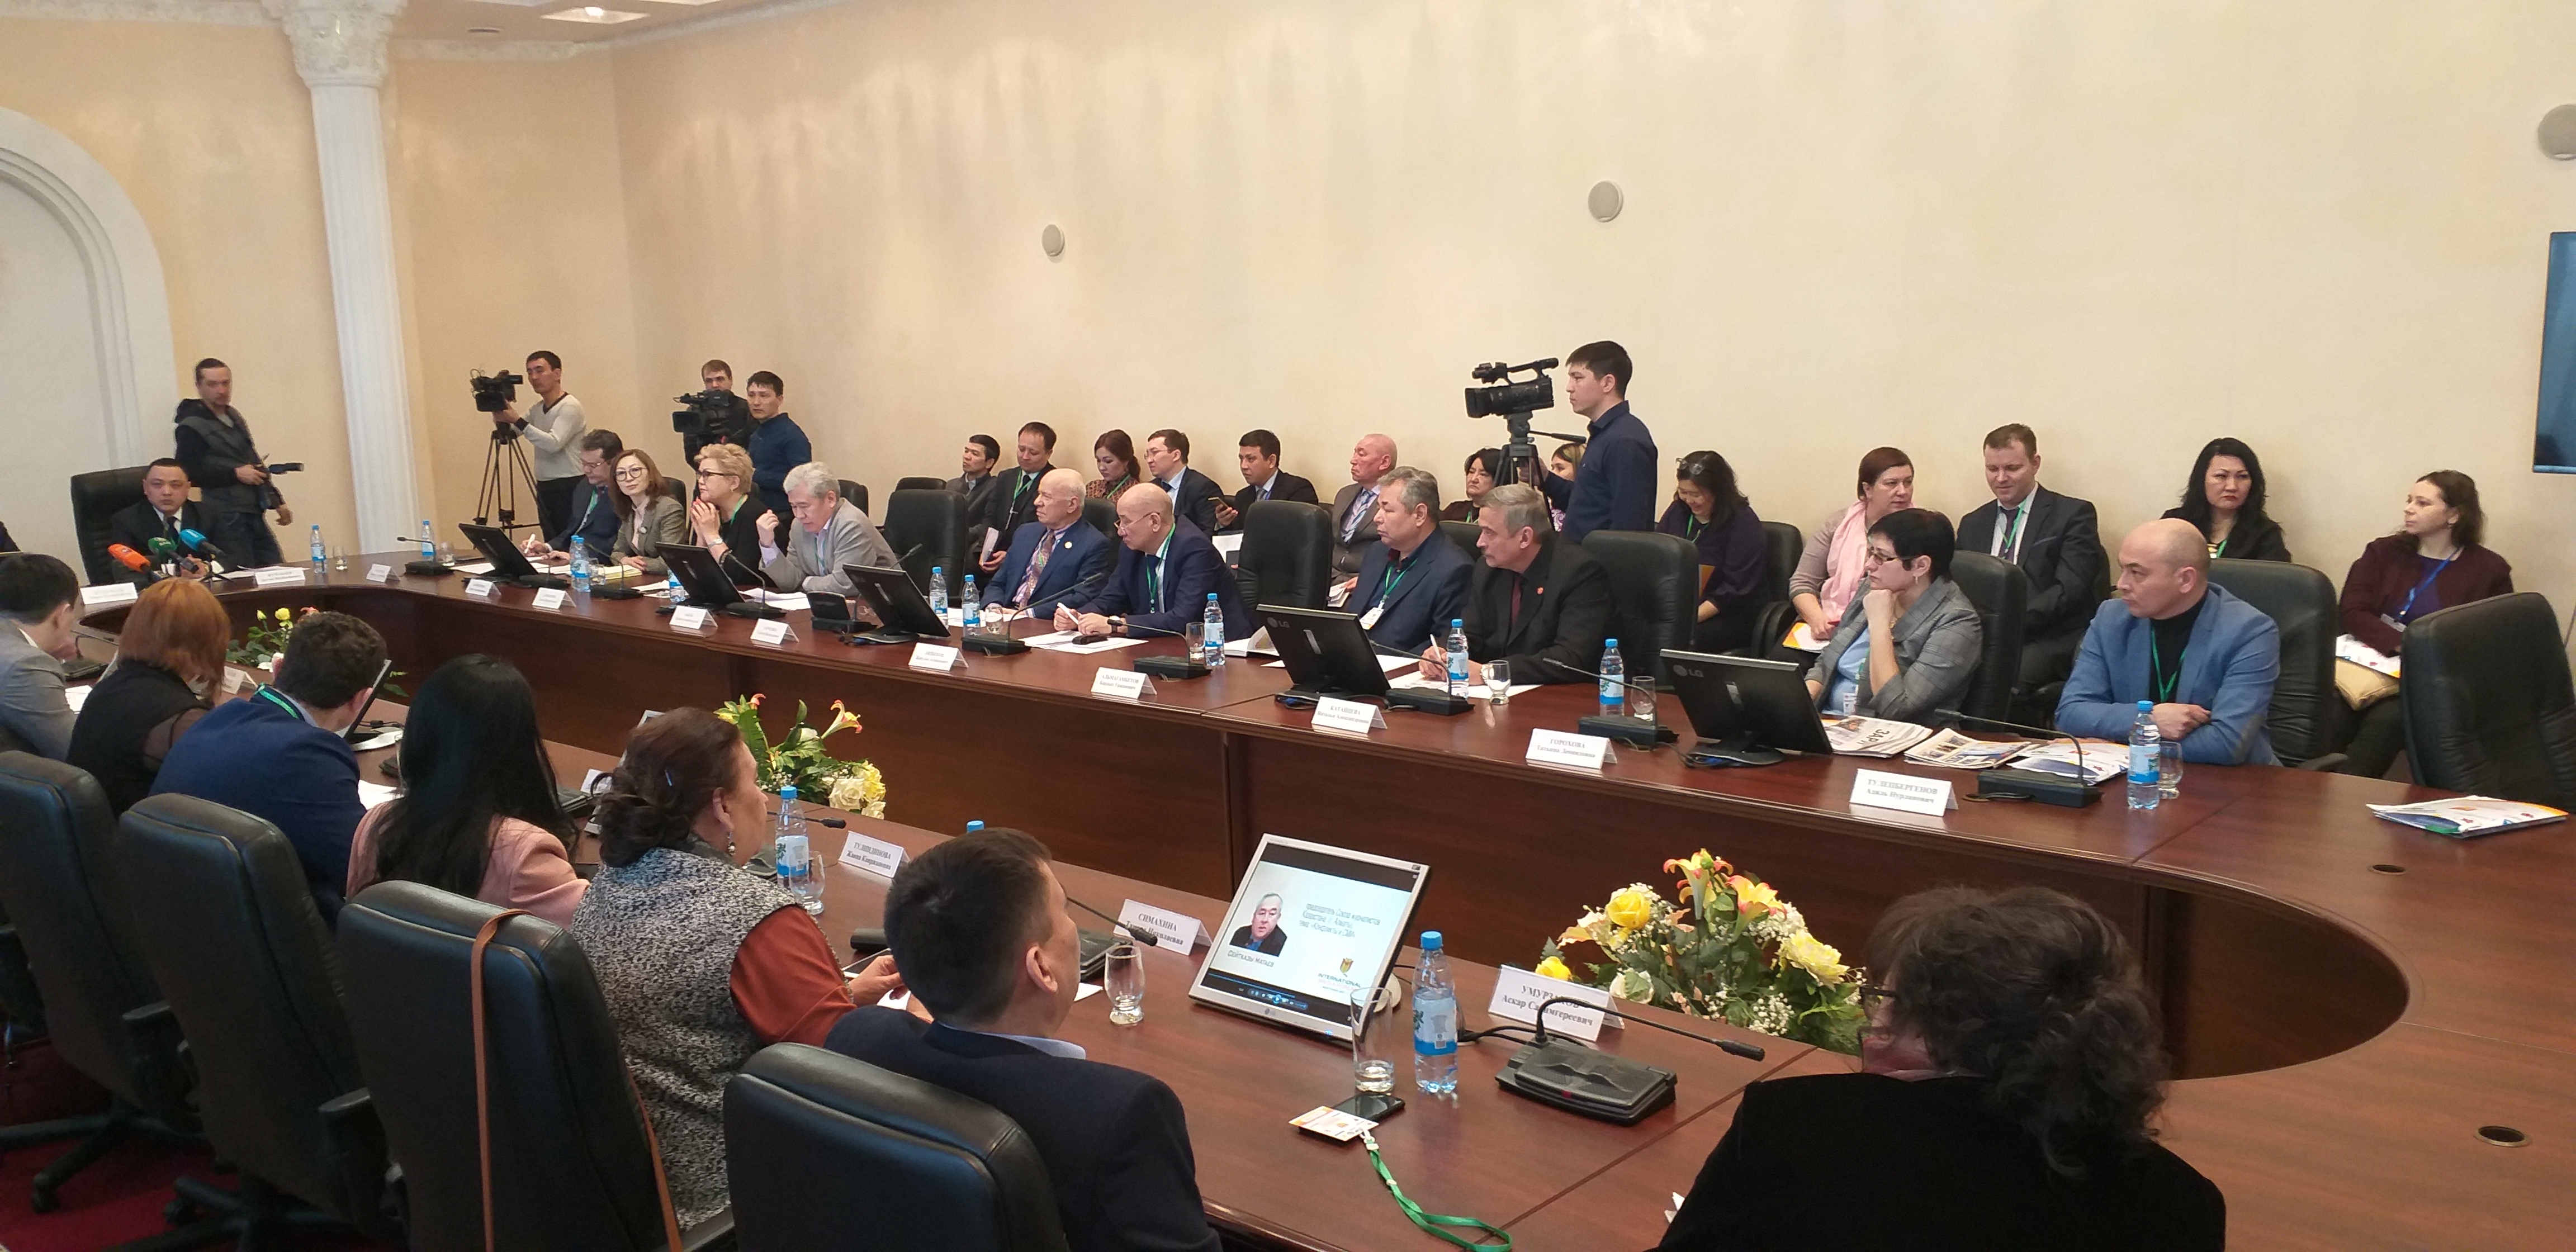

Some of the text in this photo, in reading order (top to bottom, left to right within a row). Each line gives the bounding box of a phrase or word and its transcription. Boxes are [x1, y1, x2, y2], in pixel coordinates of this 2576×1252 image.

[1688, 668, 1704, 677] LG
[1550, 738, 1585, 748] ГОРОХОВА
[1138, 913, 1177, 932] СИМАХИНА
[1317, 972, 1361, 989] INTERNATIONAL
[1502, 994, 1593, 1027] Аскар Саимгереевич
